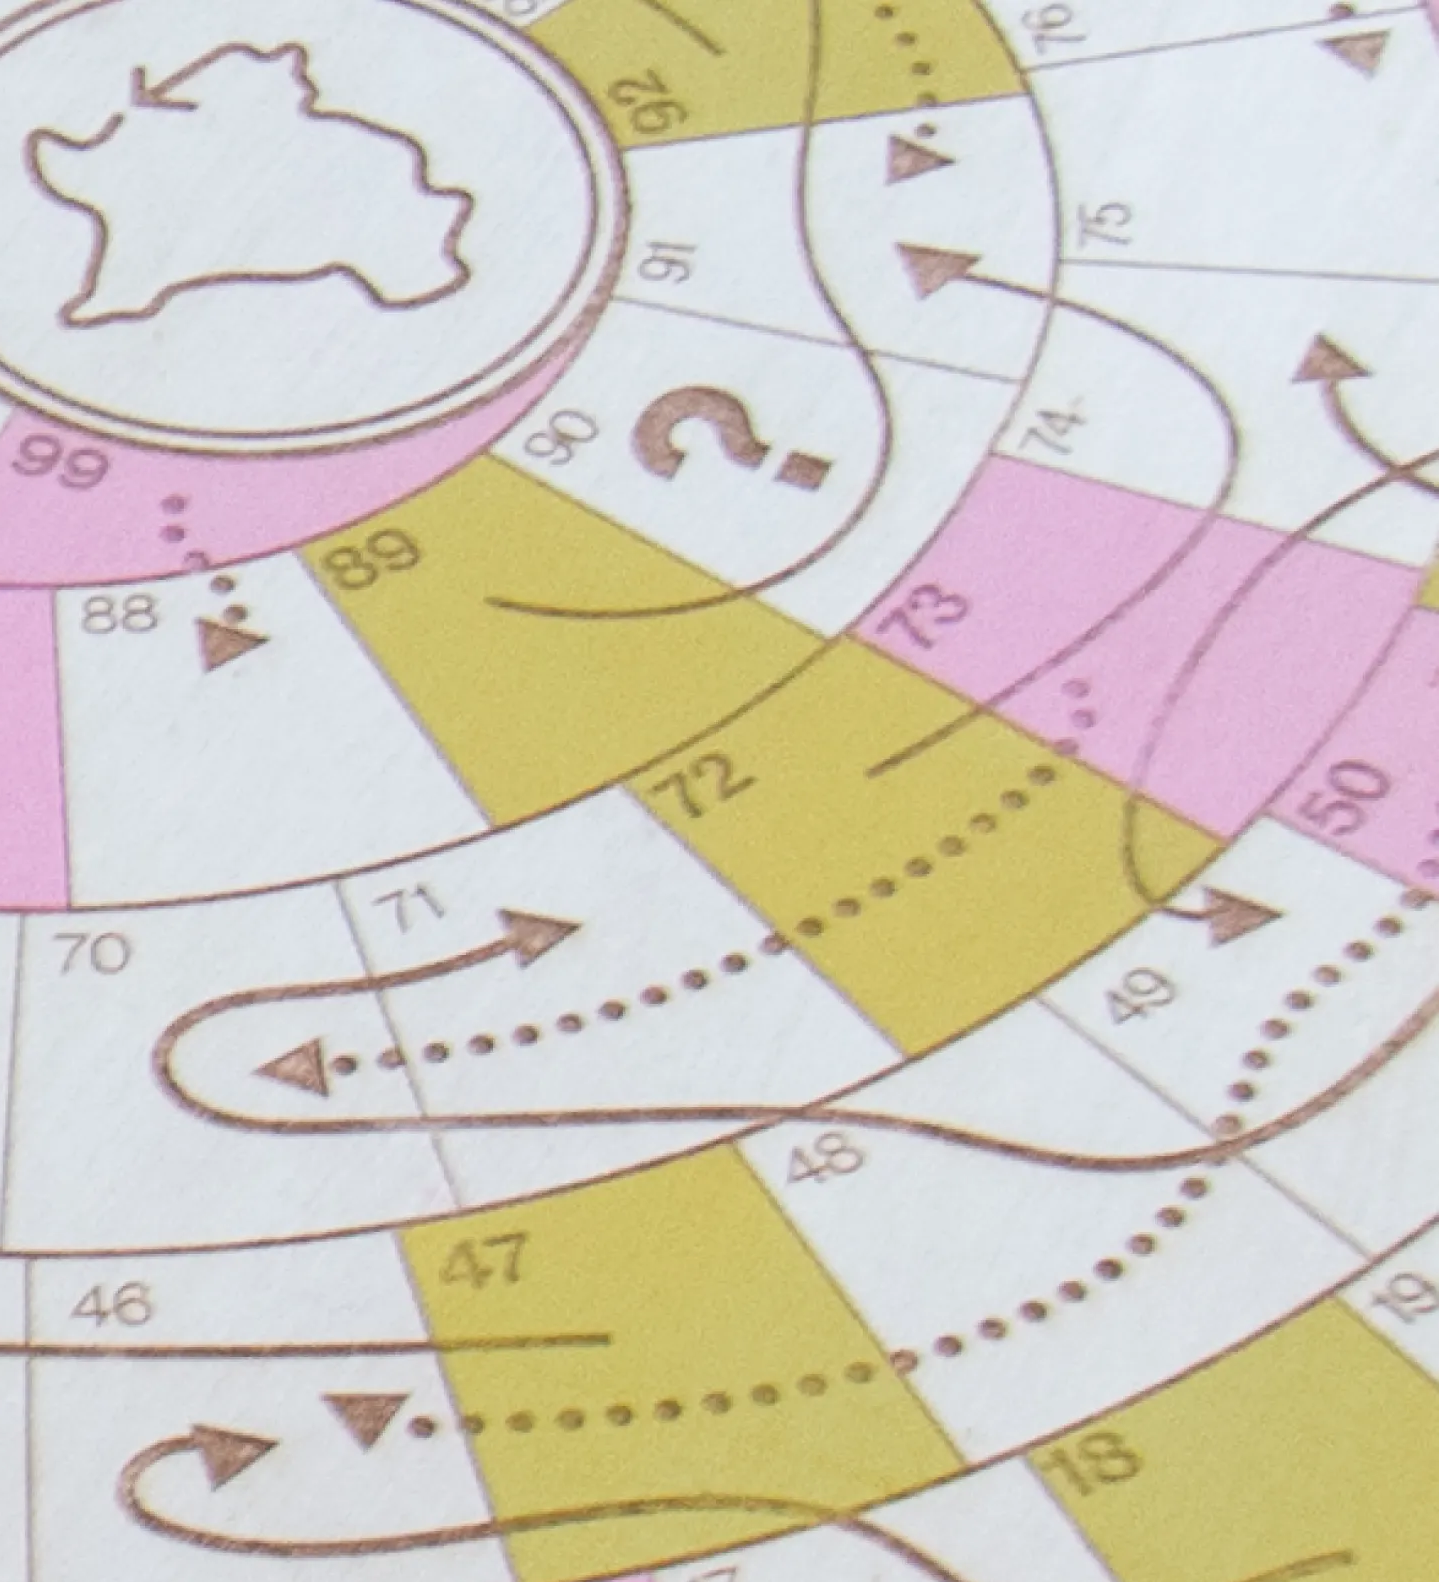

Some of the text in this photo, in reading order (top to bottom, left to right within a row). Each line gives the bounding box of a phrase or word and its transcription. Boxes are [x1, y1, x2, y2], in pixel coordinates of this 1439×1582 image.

[1019, 2, 1090, 57] 76
[607, 69, 688, 137] 92
[1075, 200, 1133, 248] 75
[638, 240, 698, 286] 91
[523, 408, 599, 467] 90
[1018, 402, 1087, 456] 74
[11, 434, 110, 492] 99
[321, 528, 422, 592] 89
[82, 594, 160, 636] 88
[875, 582, 970, 652] 73
[650, 752, 758, 820] 72
[1296, 757, 1393, 836] 50
[372, 882, 447, 937] 71
[52, 931, 133, 976] 70
[1105, 967, 1177, 1027] 49
[784, 1130, 865, 1187] 48
[440, 1230, 530, 1288] 47
[70, 1280, 155, 1328] 46
[1371, 1271, 1439, 1326] 19
[1038, 1430, 1143, 1497] 18
